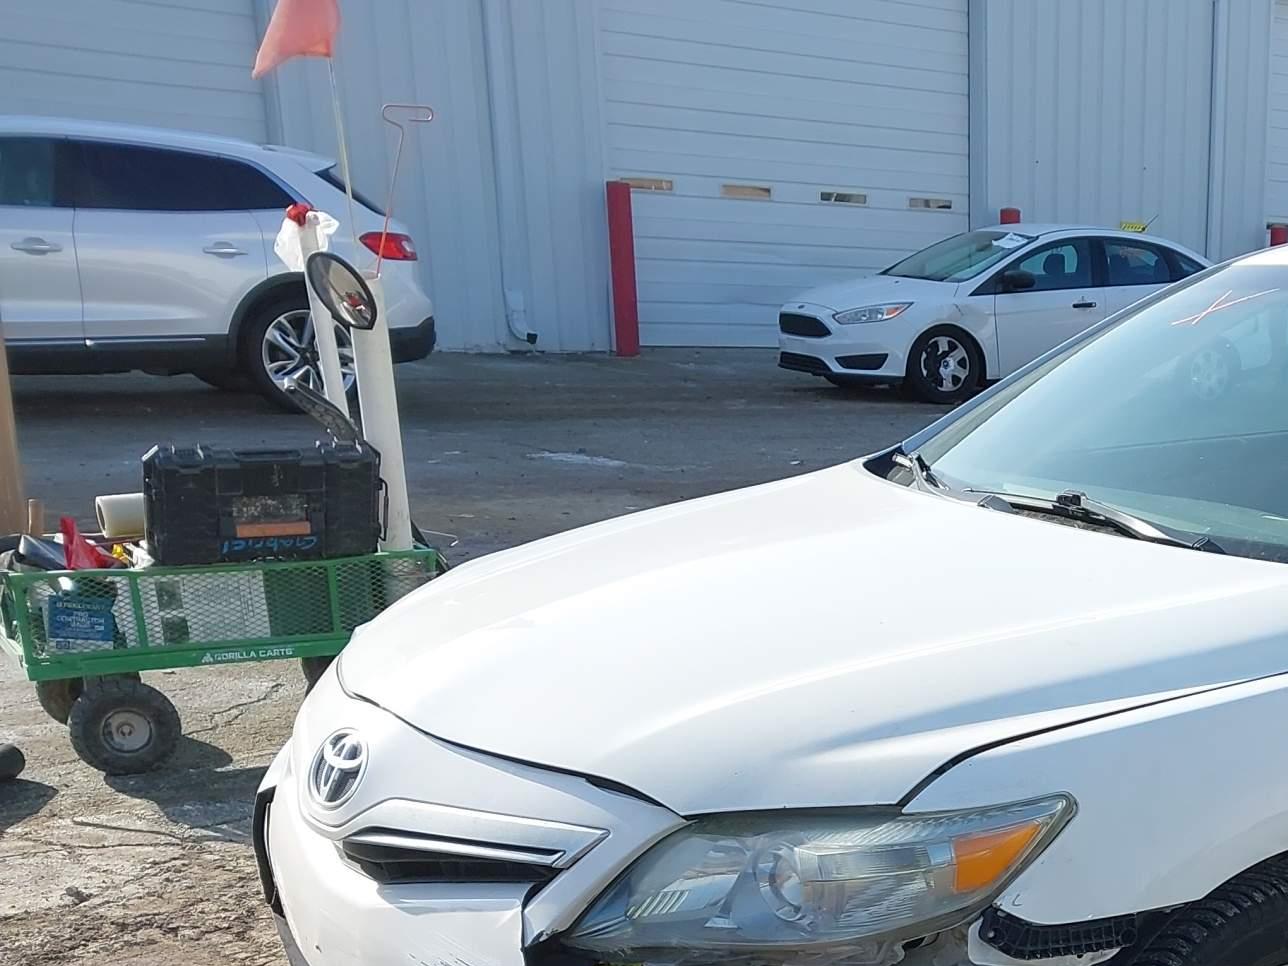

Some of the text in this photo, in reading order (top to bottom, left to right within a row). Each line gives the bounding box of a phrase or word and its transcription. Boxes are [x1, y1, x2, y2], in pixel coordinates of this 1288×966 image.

[222, 536, 319, 555] Gabriel
[214, 648, 293, 661] GORILLA CARTS
